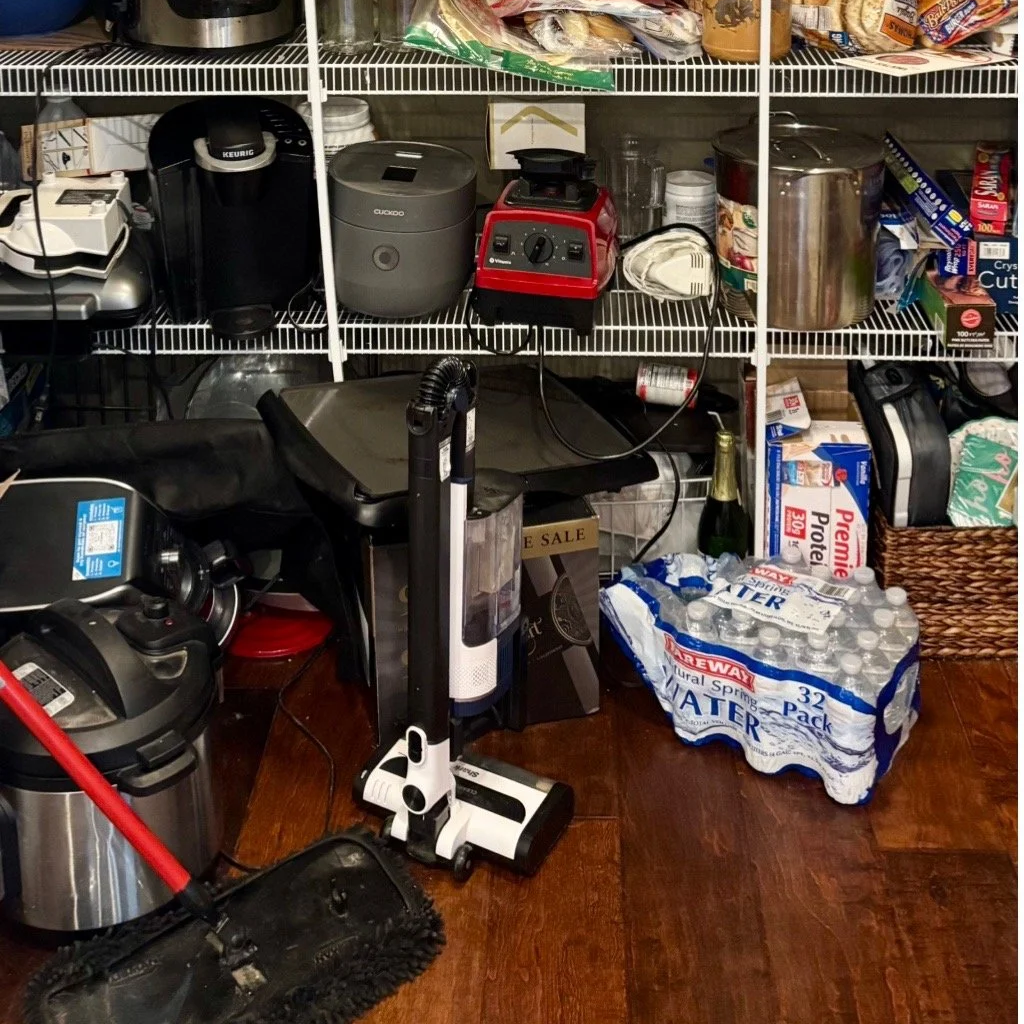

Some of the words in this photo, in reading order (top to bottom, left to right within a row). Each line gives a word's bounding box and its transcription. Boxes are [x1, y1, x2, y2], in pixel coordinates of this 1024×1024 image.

[222, 149, 254, 159] KEURIG
[975, 169, 999, 197] SARAN
[373, 208, 405, 217] CUCKOO
[977, 202, 999, 210] SARAN
[977, 223, 993, 233] 100
[494, 258, 512, 266] Vitamix
[860, 461, 868, 485] Vanilla
[791, 509, 806, 536] 30g
[541, 527, 586, 547] SALE
[809, 510, 830, 568] Protei
[834, 508, 855, 579] Premie
[749, 577, 790, 595] Spring
[712, 680, 758, 712] Spring
[797, 686, 826, 711] 32
[783, 701, 832, 735] Pack
[455, 764, 480, 778] Shark
